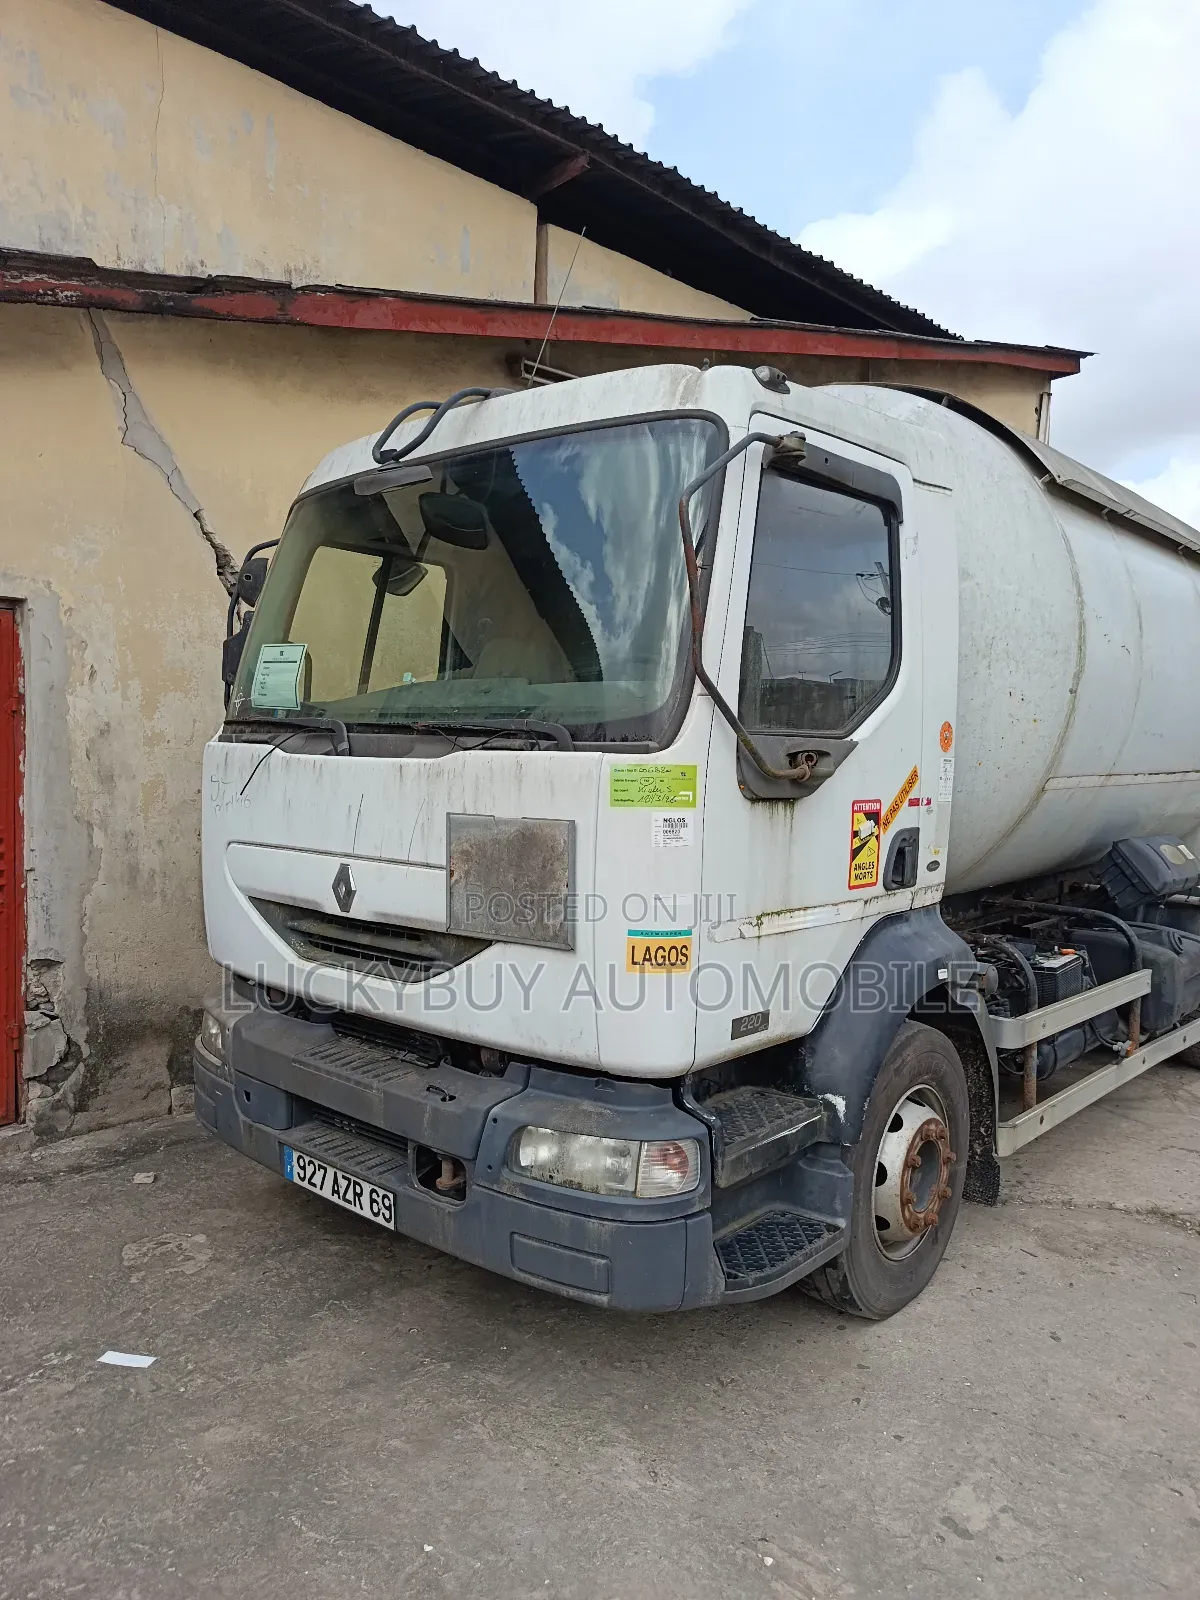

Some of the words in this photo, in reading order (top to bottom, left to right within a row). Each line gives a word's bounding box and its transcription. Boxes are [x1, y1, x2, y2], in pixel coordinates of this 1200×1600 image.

[853, 802, 880, 811] ATTENTION
[882, 814, 891, 829] NE
[889, 801, 900, 819] PAS
[899, 770, 918, 804] UTILISER
[853, 859, 875, 872] ANGLES
[853, 869, 874, 881] MORTS
[631, 944, 689, 967] LAGOS
[740, 1013, 762, 1031] 220
[287, 1165, 291, 1173] F
[296, 1154, 328, 1191] 927
[331, 1171, 364, 1211] AZR
[369, 1187, 393, 1224] 69
